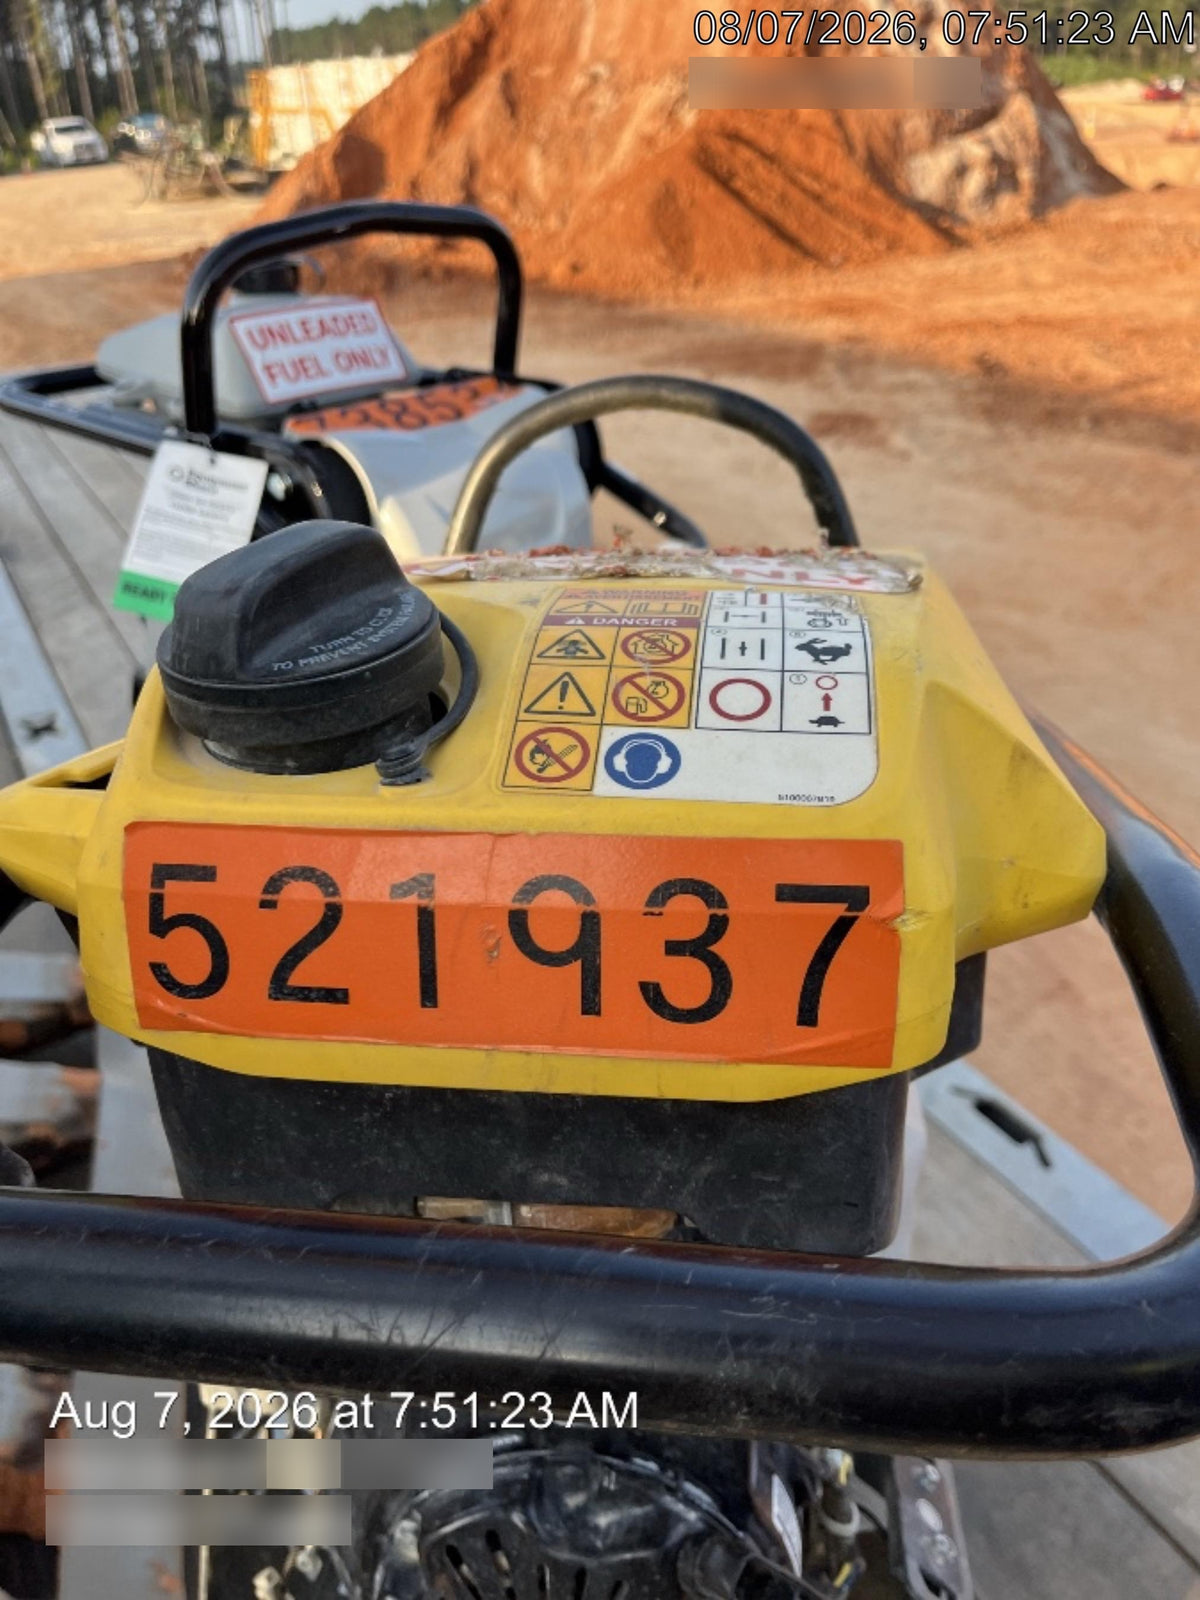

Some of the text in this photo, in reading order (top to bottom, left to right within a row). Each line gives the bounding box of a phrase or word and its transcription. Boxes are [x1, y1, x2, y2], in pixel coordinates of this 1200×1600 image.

[247, 311, 378, 348] UNLEADED
[263, 345, 391, 387] FUEL ONLY
[592, 616, 678, 627] DANGER
[148, 862, 872, 1028] 521937
